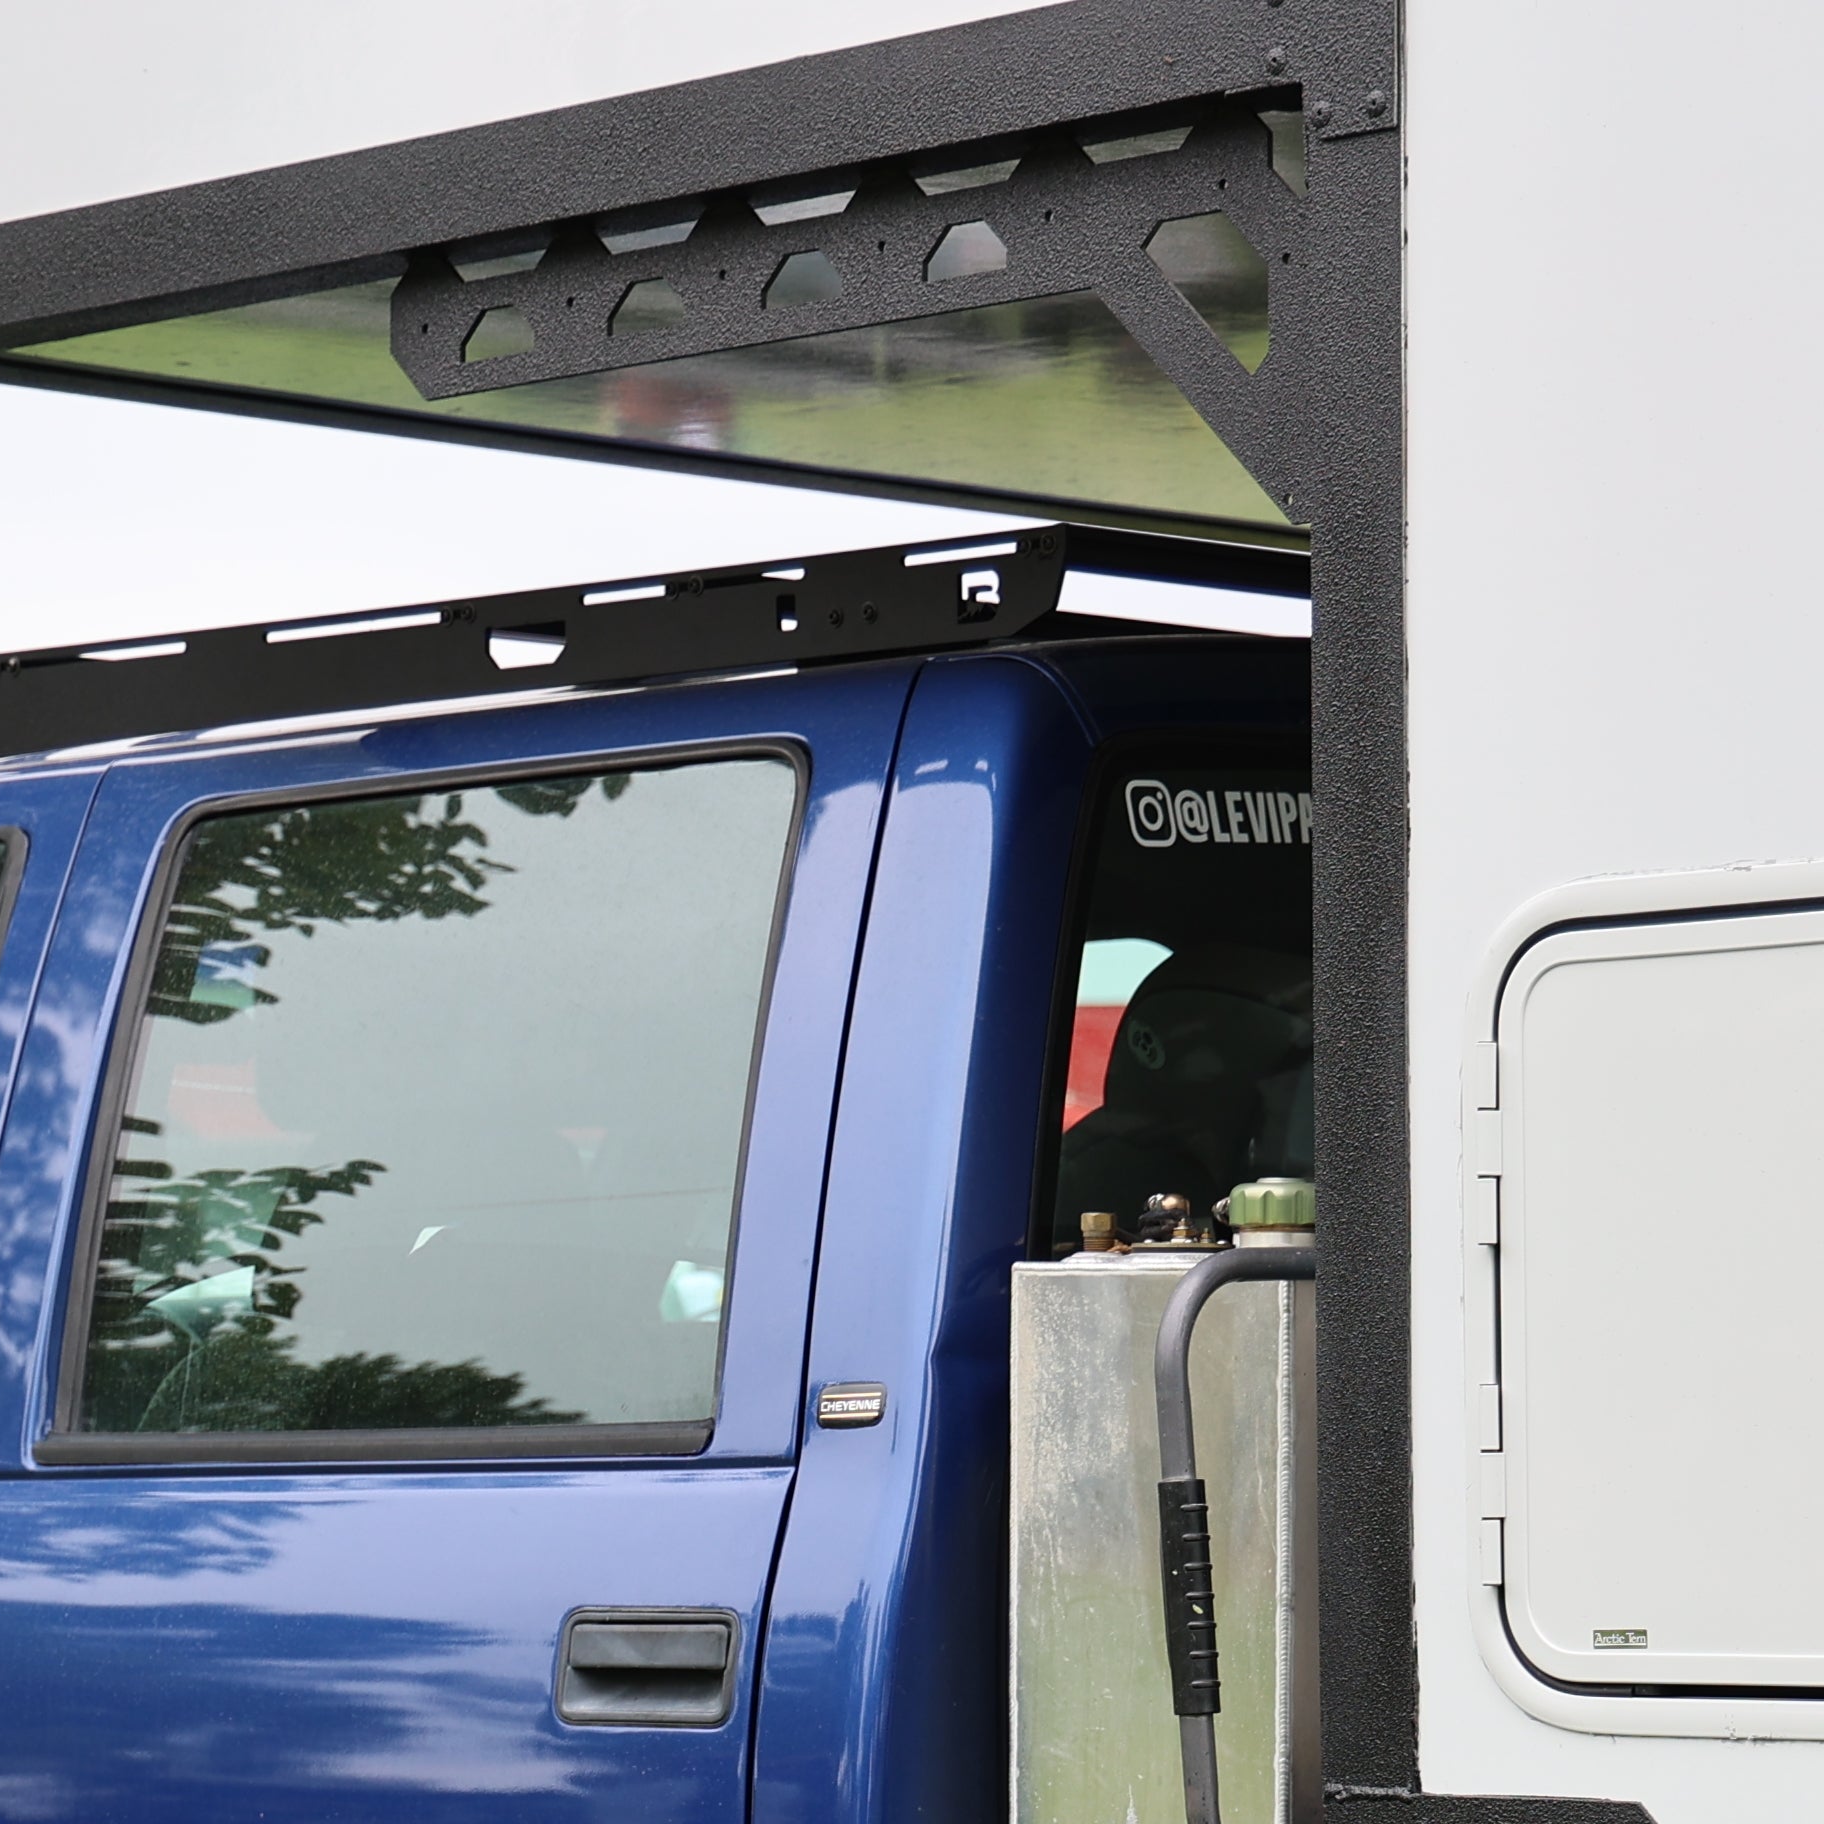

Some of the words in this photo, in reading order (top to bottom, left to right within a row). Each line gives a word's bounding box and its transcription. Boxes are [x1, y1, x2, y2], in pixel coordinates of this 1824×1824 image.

[820, 1399, 881, 1412] CHEYENNE
[1595, 1633, 1625, 1644] Arctic
[1627, 1632, 1646, 1643] Tern
